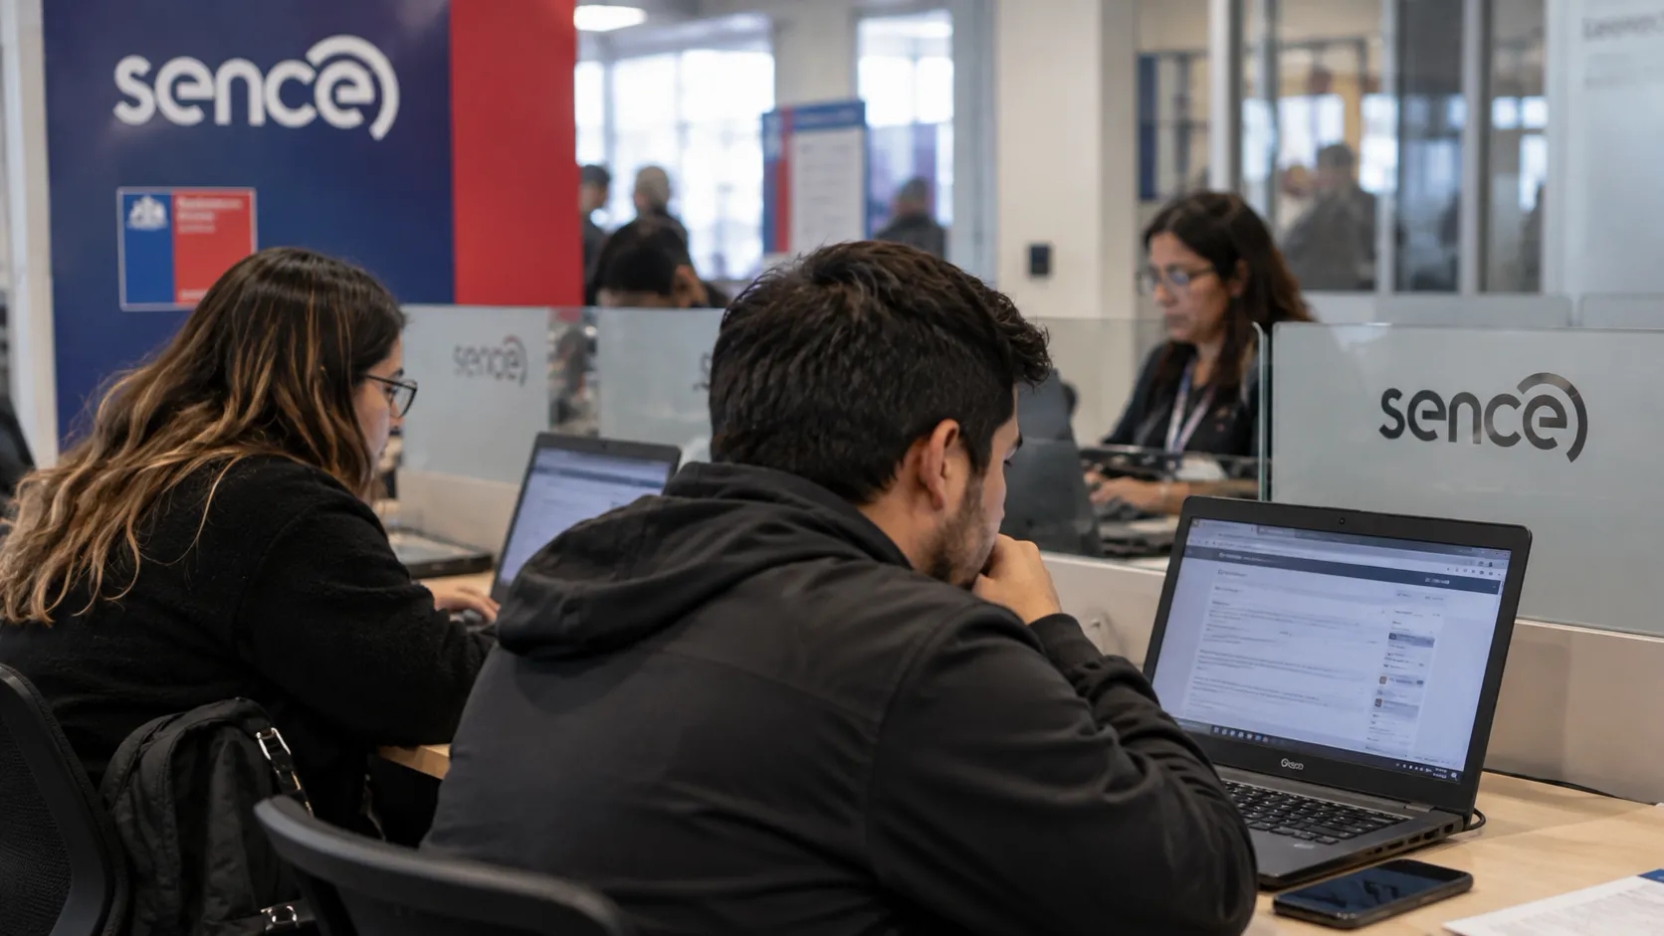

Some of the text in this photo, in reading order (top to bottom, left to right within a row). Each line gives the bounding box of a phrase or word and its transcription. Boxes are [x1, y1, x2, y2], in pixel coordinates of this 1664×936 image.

[113, 34, 399, 141] sence
[453, 335, 528, 388] sence
[1379, 372, 1588, 463] sence
